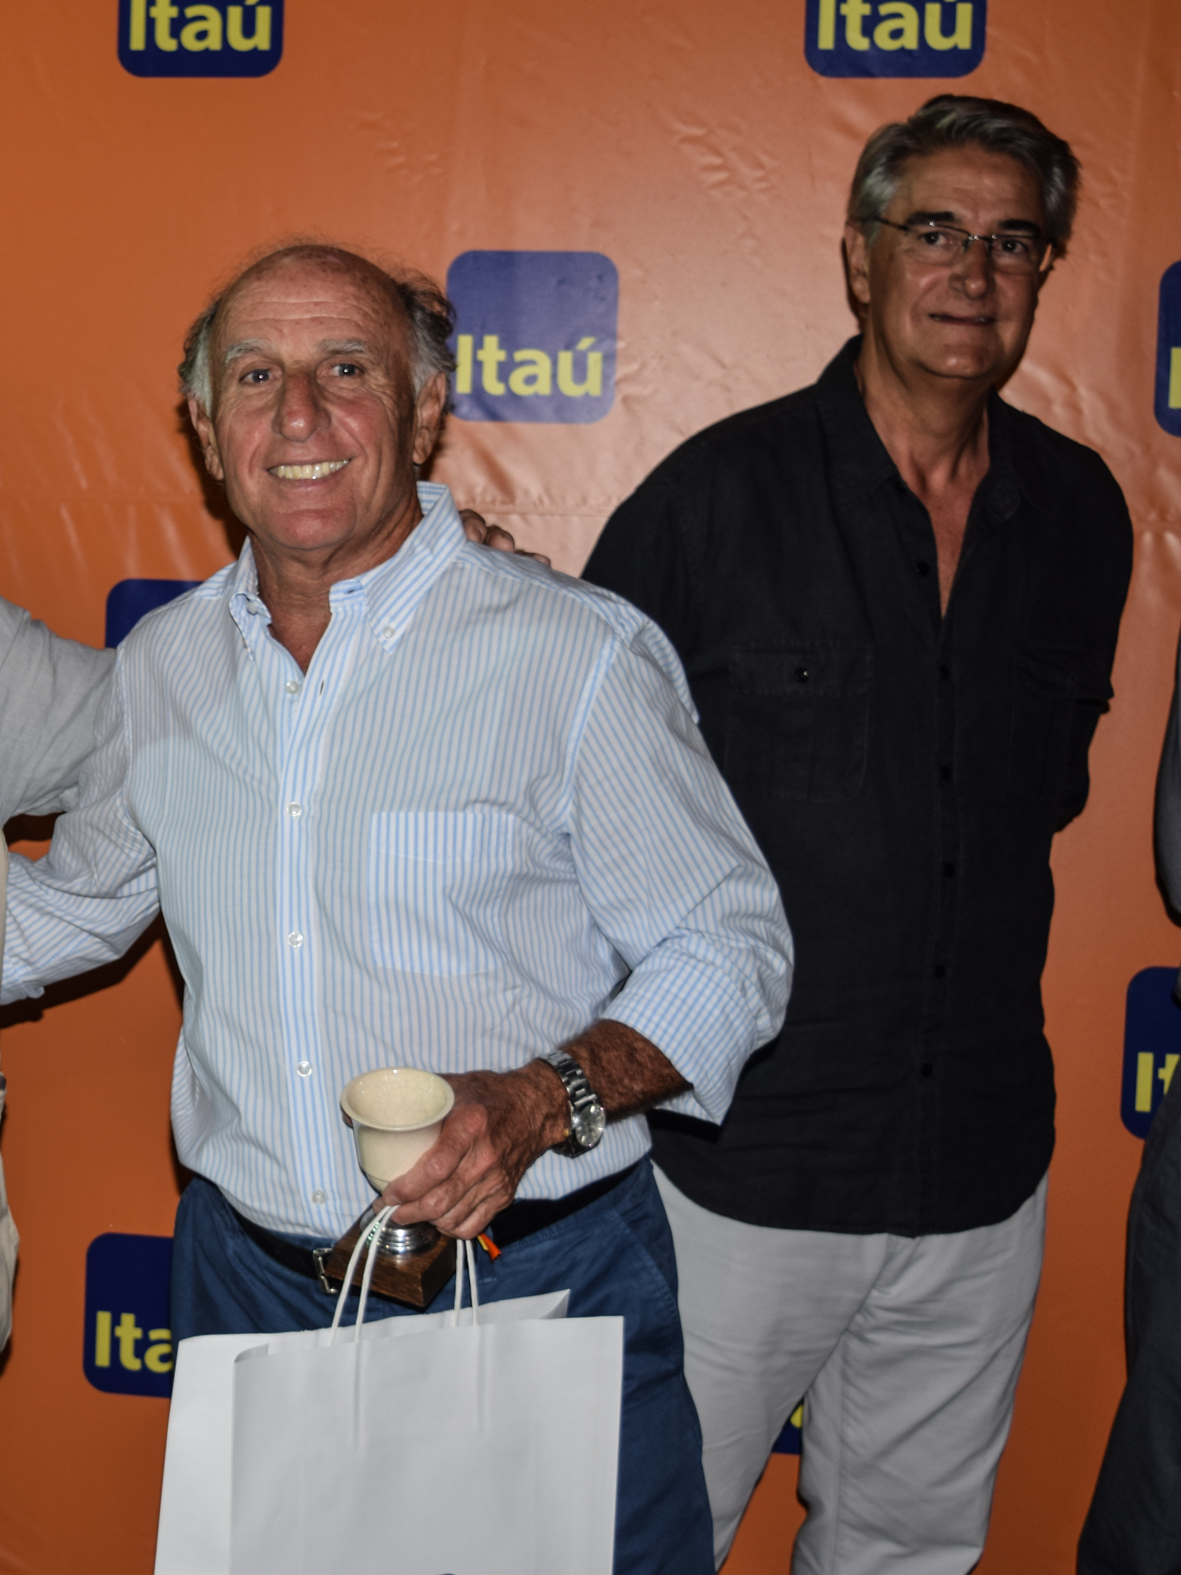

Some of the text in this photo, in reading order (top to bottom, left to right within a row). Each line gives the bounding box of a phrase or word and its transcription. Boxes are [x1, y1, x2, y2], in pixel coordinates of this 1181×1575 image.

[130, 0, 271, 52] Itaú
[817, 0, 973, 51] Itaú
[455, 334, 603, 397] Itaú
[95, 1310, 173, 1373] Ita
